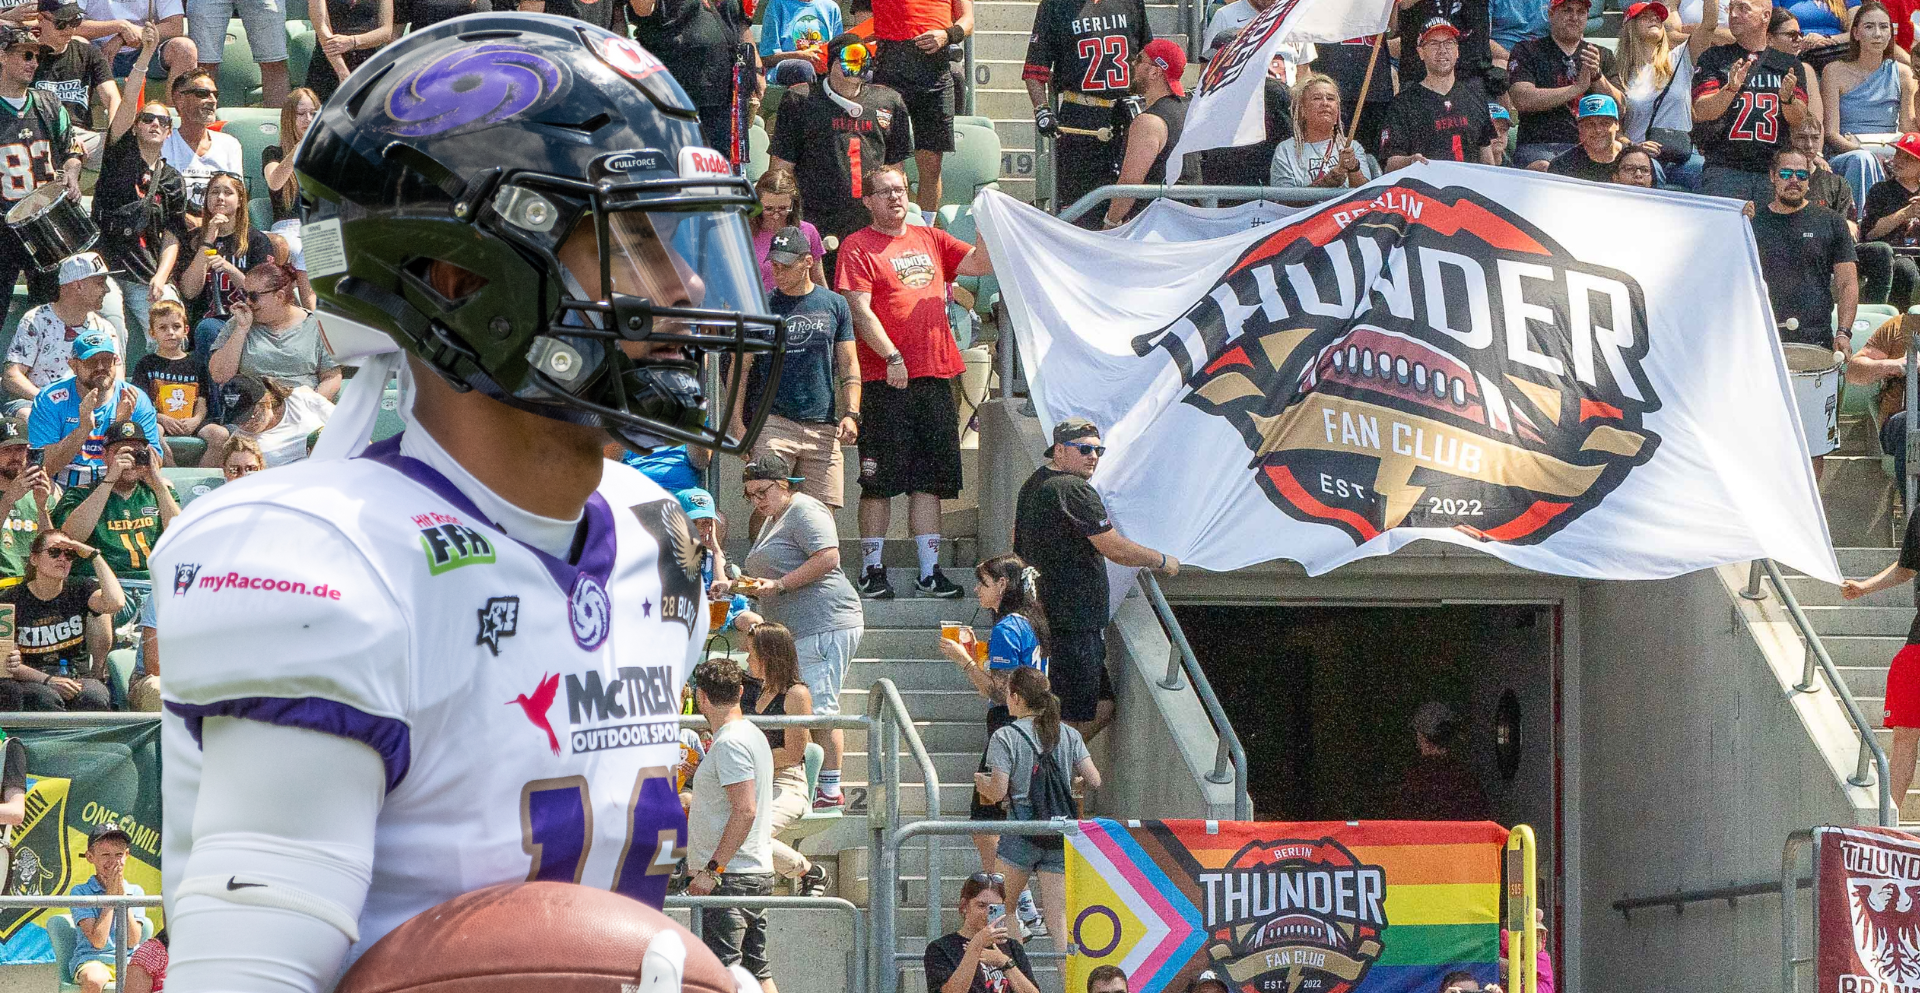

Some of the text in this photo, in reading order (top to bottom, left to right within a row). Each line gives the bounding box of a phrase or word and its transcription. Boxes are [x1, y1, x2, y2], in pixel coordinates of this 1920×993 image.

[1071, 14, 1128, 35] BERLIN
[1077, 35, 1130, 91] 23
[1748, 73, 1782, 88] RLIN
[1729, 91, 1779, 143] 23
[0, 140, 56, 200] 83
[614, 158, 656, 169] FULLFORCE
[1001, 153, 1033, 175] 19
[797, 319, 825, 334] Rock
[1147, 234, 1645, 403] THUNDER
[51, 389, 68, 401] KFC
[1322, 408, 1483, 474] FAN CLUB
[1320, 472, 1484, 516] EST. 2022
[107, 516, 155, 532] LEIPZIG
[120, 531, 152, 569] 11
[420, 523, 492, 565] FFH
[198, 571, 342, 601] myRacoon.de
[662, 595, 676, 617] 28
[17, 614, 84, 647] KINGS
[564, 665, 679, 724] McTREK
[572, 725, 651, 752] OUTDOOR
[81, 801, 163, 858] ONE FAMIL
[1273, 847, 1313, 861] BERLIN
[1199, 869, 1384, 928] THUNDER
[1265, 950, 1326, 968] FAN CLUB
[1263, 979, 1322, 990] EST. 2022
[1841, 977, 1920, 993] BRA
